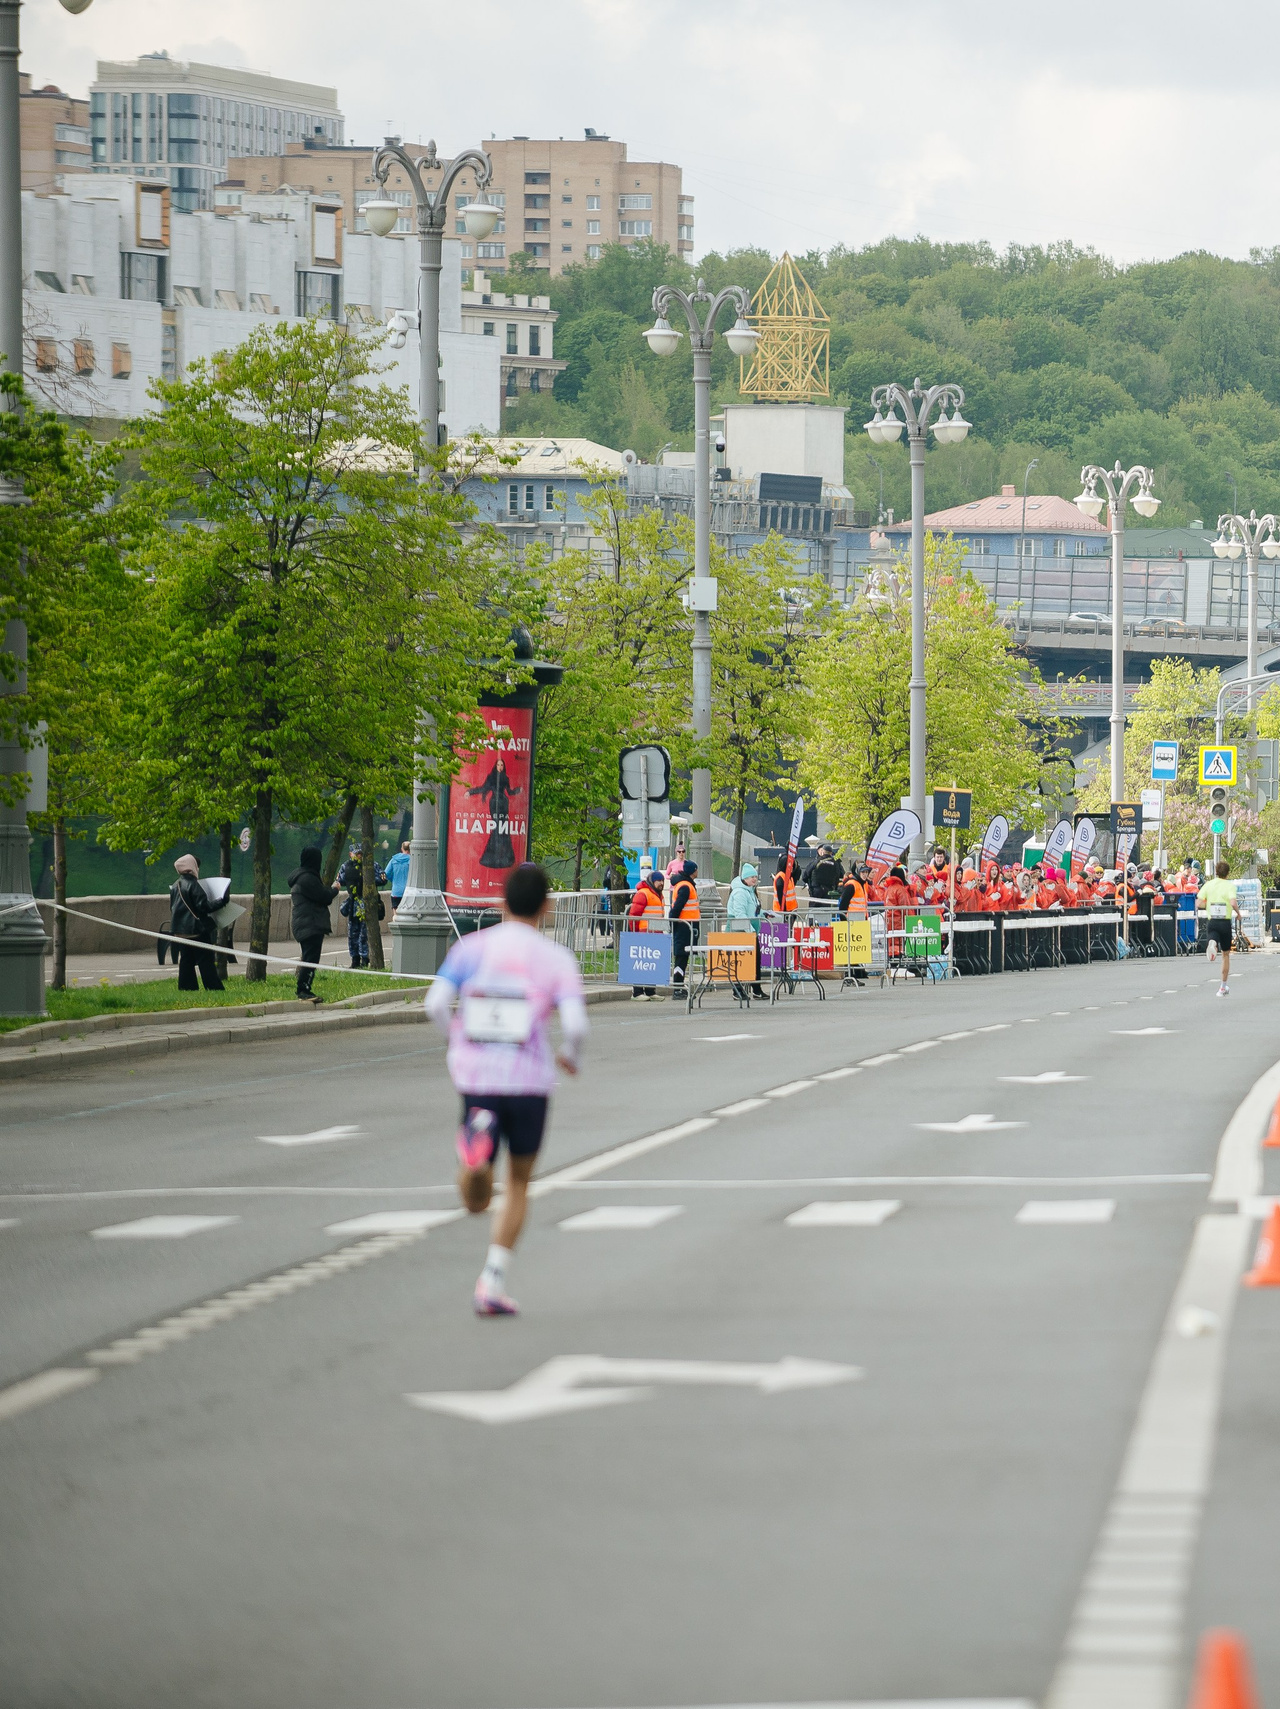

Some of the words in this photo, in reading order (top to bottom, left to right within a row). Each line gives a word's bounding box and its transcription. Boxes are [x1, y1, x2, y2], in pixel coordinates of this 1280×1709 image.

[507, 738, 530, 751] ASTI
[943, 808, 960, 818] Вода
[455, 818, 526, 836] ЦАРИЦА
[758, 933, 780, 945] lite
[629, 945, 661, 959] Elite
[835, 944, 867, 952] Women
[632, 960, 656, 971] Men
